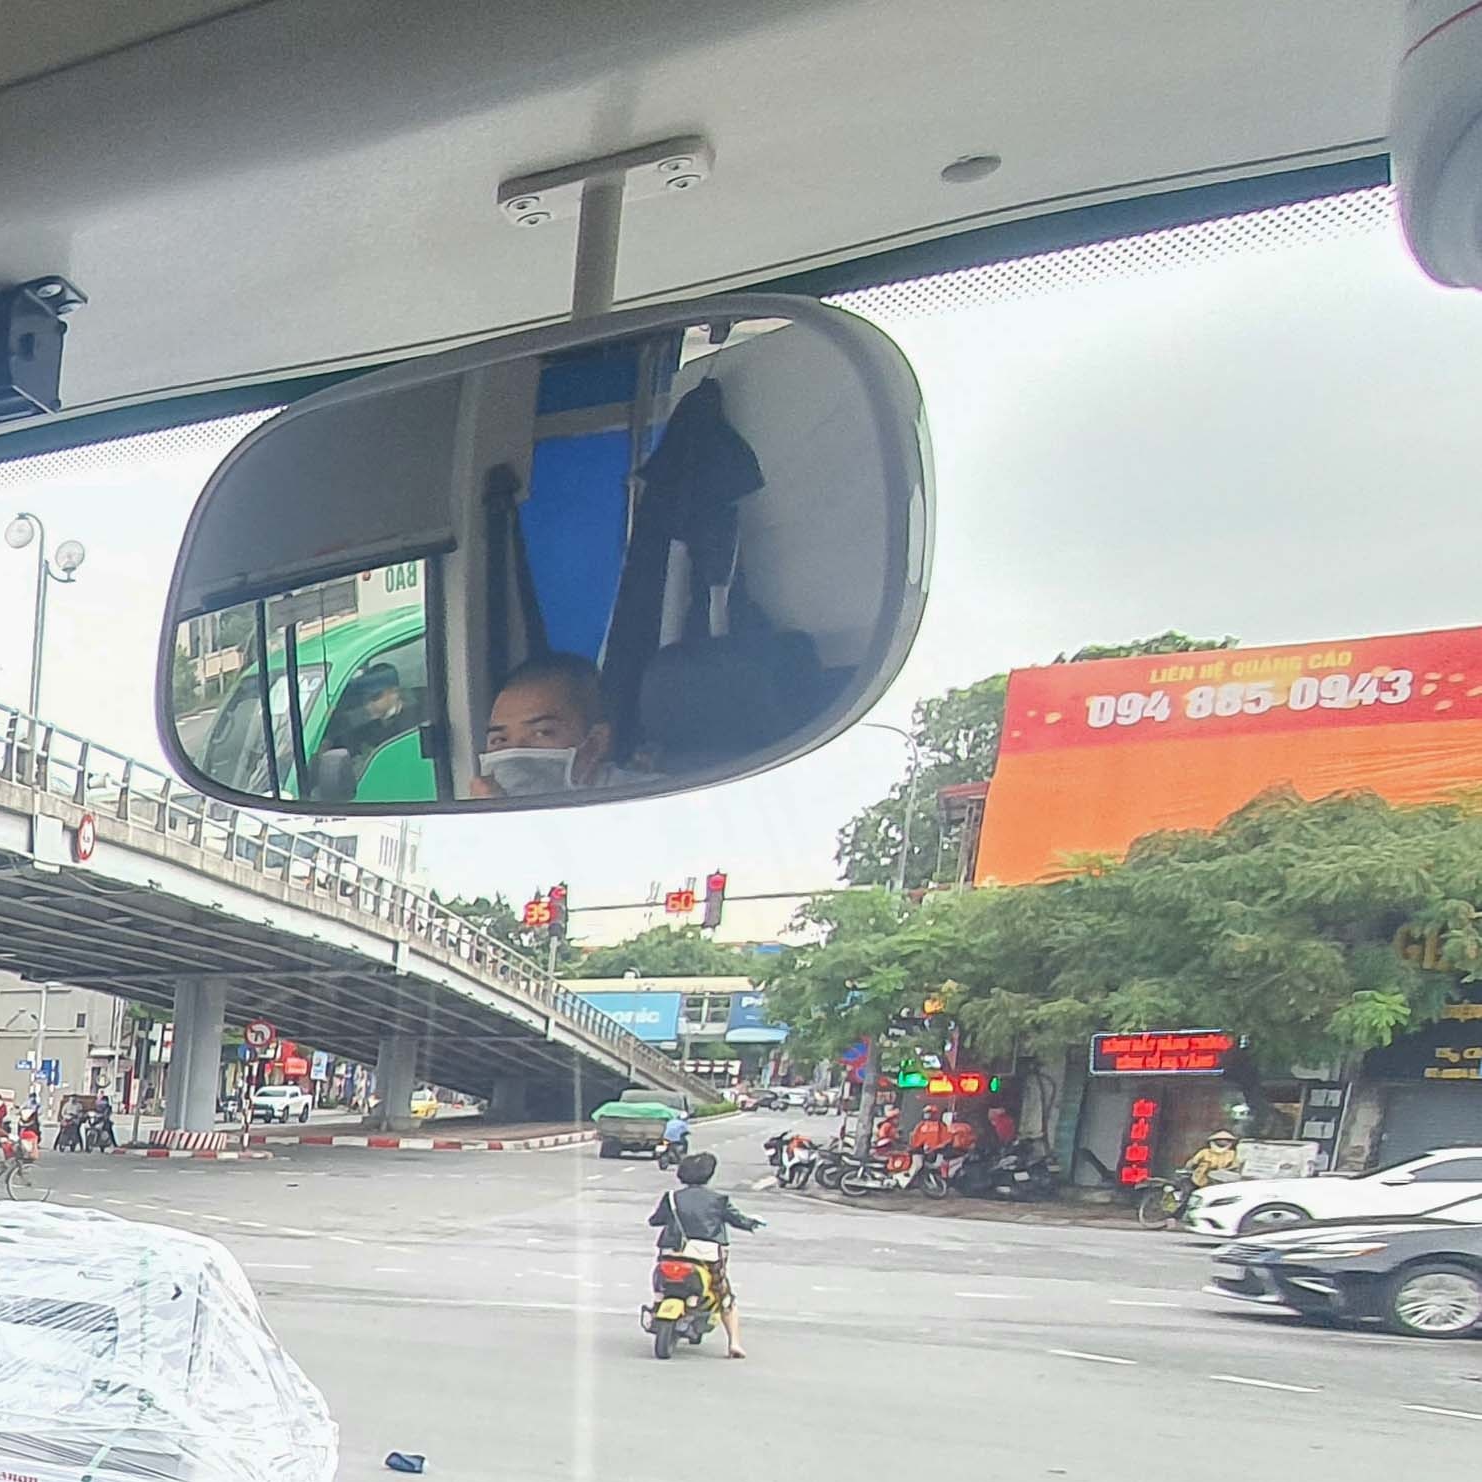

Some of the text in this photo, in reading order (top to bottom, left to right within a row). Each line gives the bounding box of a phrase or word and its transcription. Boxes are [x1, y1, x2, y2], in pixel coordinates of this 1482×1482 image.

[1087, 669, 1413, 728] 094 885 0943
[667, 892, 694, 912] 60
[525, 903, 552, 924] 35
